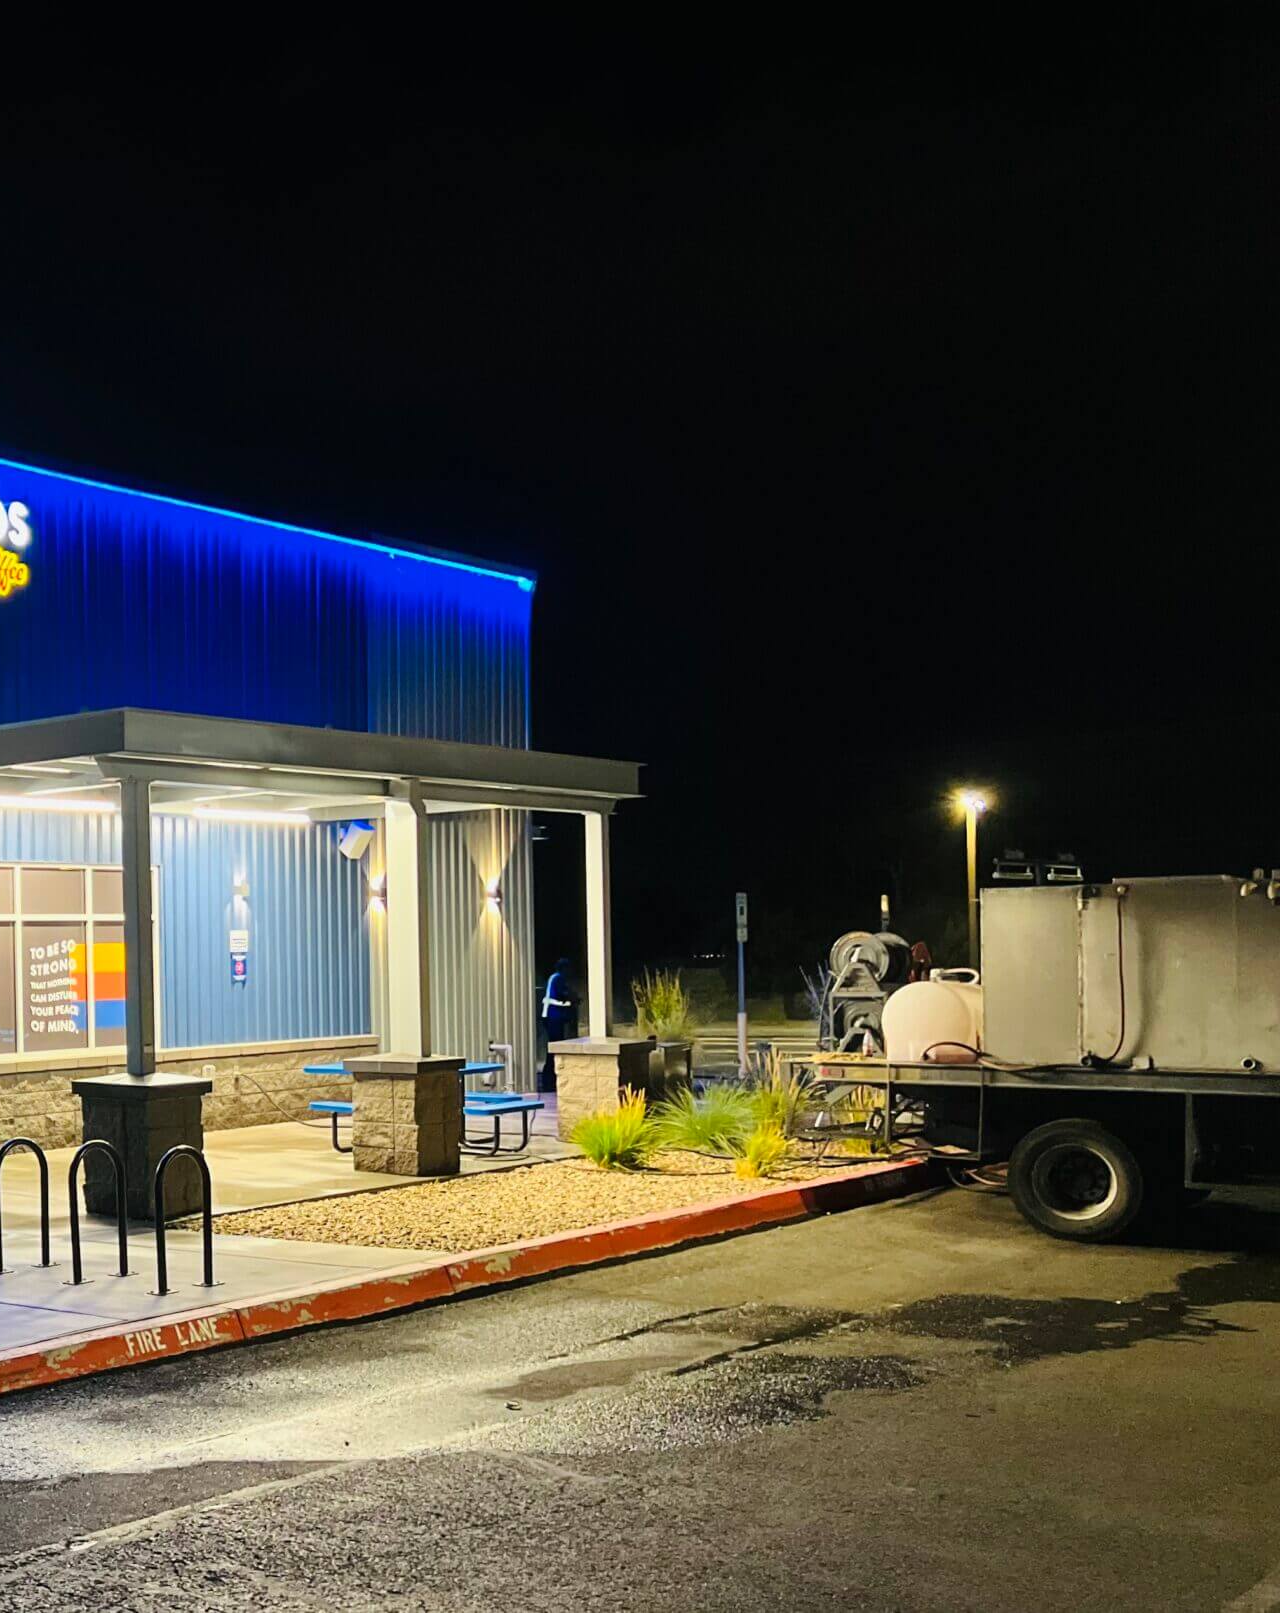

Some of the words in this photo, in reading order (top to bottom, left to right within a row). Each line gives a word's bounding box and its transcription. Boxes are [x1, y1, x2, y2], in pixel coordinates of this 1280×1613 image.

[30, 947, 45, 960] TO
[46, 942, 59, 957] BE
[61, 939, 76, 954] SO
[30, 958, 77, 976] STRONG
[30, 994, 47, 1003] CAN
[48, 990, 78, 1002] DISTURB
[30, 1006, 54, 1017] YOUR
[55, 1004, 79, 1016] PEACE
[30, 1020, 45, 1033] OF
[125, 1328, 167, 1357] FIRE
[174, 1317, 220, 1346] LANE
